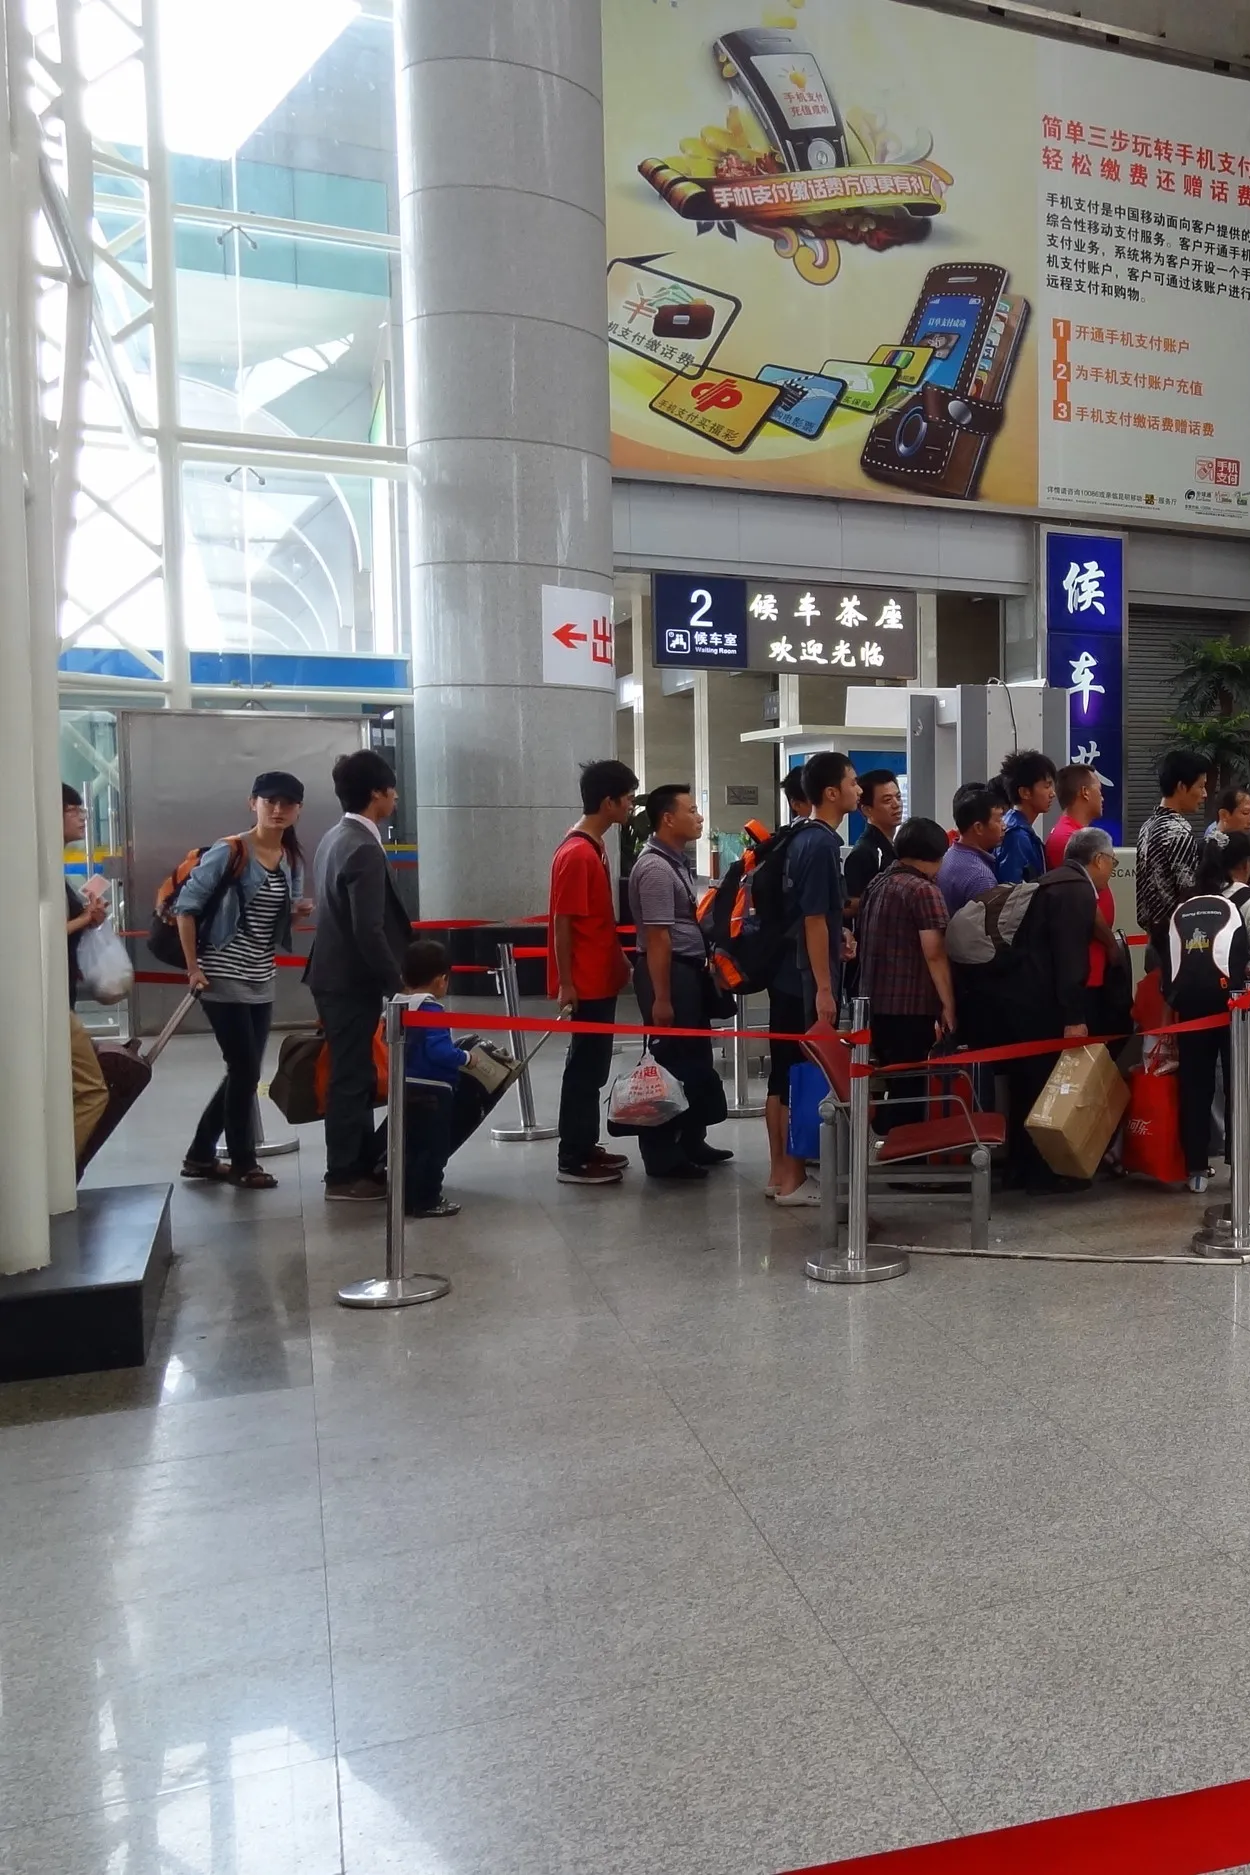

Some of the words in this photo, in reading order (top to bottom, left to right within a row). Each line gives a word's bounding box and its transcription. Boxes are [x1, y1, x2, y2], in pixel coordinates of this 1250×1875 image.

[783, 91, 825, 103] 手机支付
[713, 175, 929, 209] 手机支付缴话费方便更有礼
[1046, 274, 1146, 303] 远程支付和购物。
[1056, 322, 1065, 337] 1
[1075, 325, 1190, 355] 开通手机支付账户
[1056, 364, 1067, 379] 2
[1075, 365, 1203, 396] 为手机支付账户充值
[657, 399, 740, 443] 手机支付买福彩
[1057, 403, 1068, 419] 3
[1075, 407, 1215, 437] 手机支付缴话费赠话费
[1217, 473, 1238, 485] 支付
[1218, 461, 1238, 474] 手机
[690, 589, 713, 627] 2
[749, 592, 904, 629] 候车茶座
[592, 616, 613, 667] 出
[694, 631, 737, 646] 候车室
[695, 646, 718, 655] Waiting
[768, 635, 885, 667] 欢迎光临
